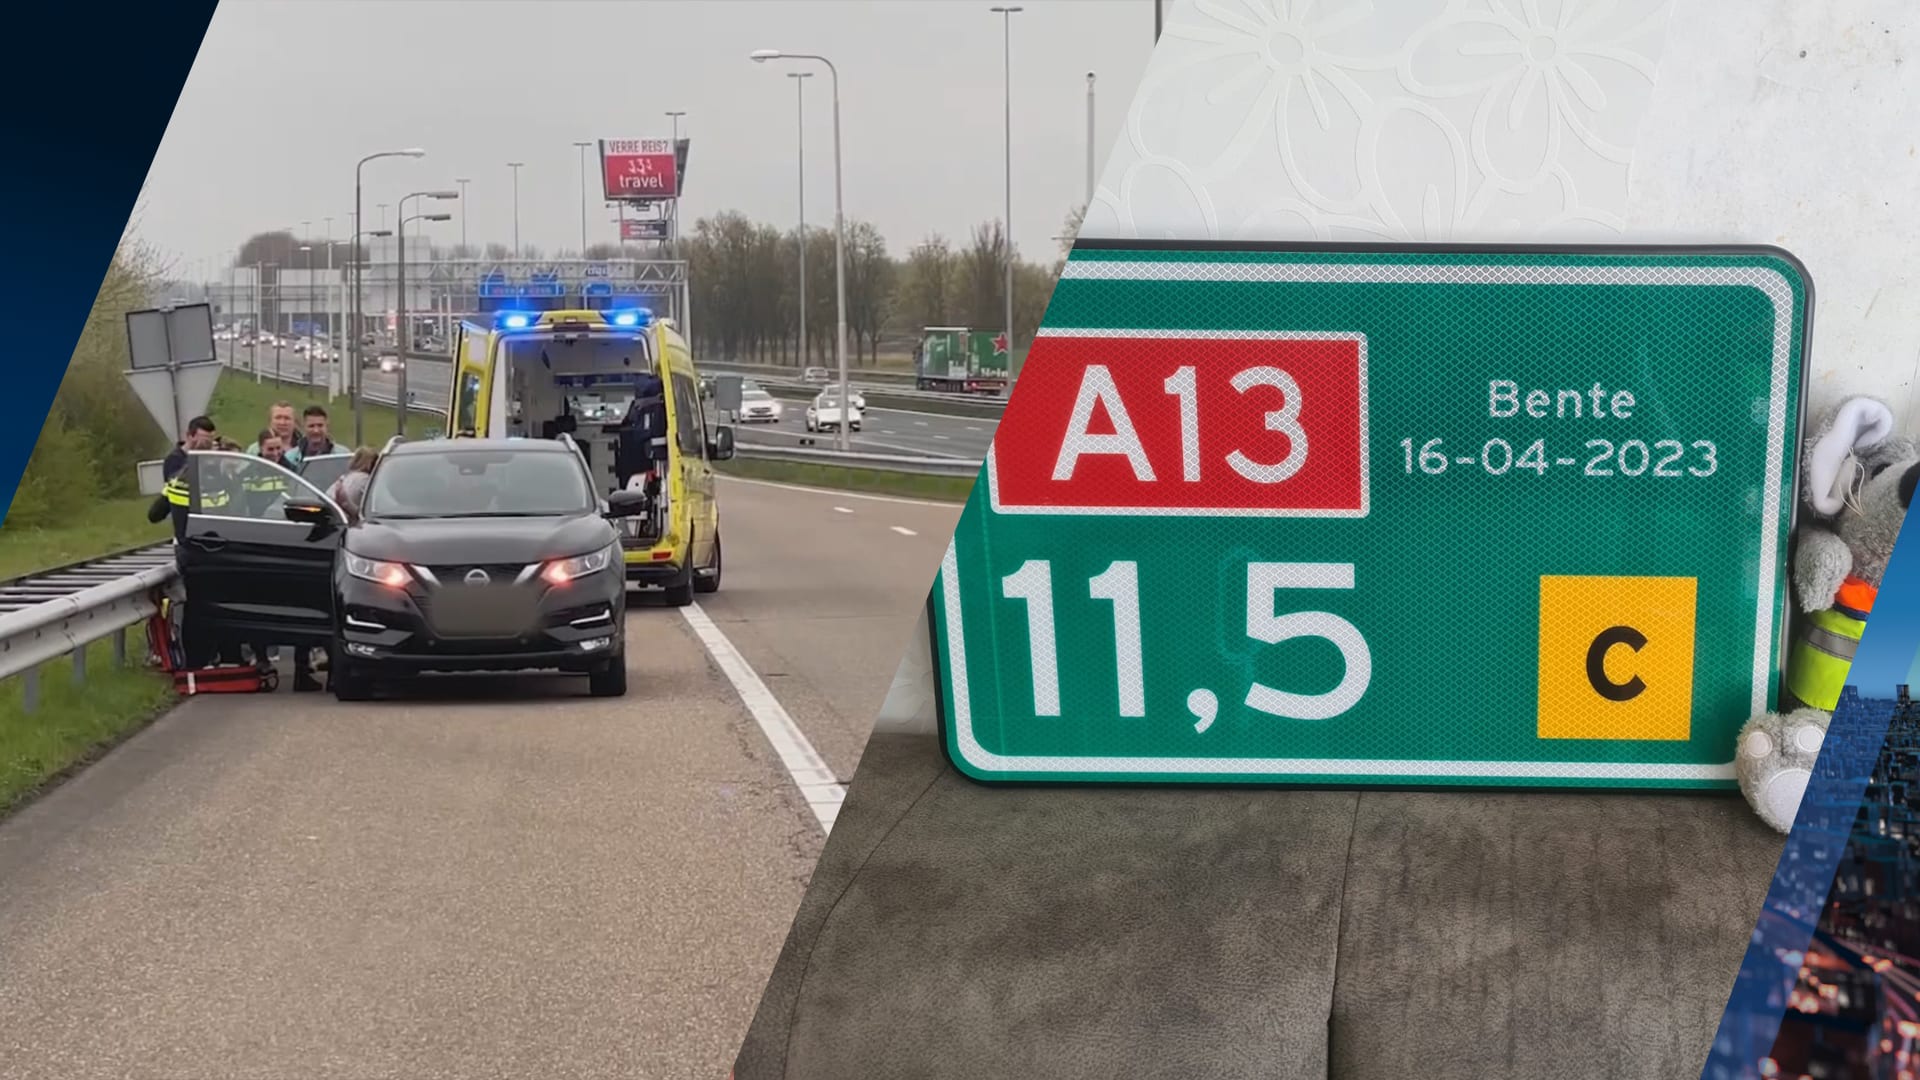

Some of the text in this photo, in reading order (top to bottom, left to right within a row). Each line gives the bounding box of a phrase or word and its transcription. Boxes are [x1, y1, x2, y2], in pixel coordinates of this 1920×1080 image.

[609, 140, 668, 153] VERRE REIS?
[619, 173, 664, 188] travel
[1489, 379, 1636, 418] Bente
[1051, 364, 1309, 484] A13
[1400, 437, 1718, 477] 16-04-2023
[1002, 559, 1372, 734] 11,5
